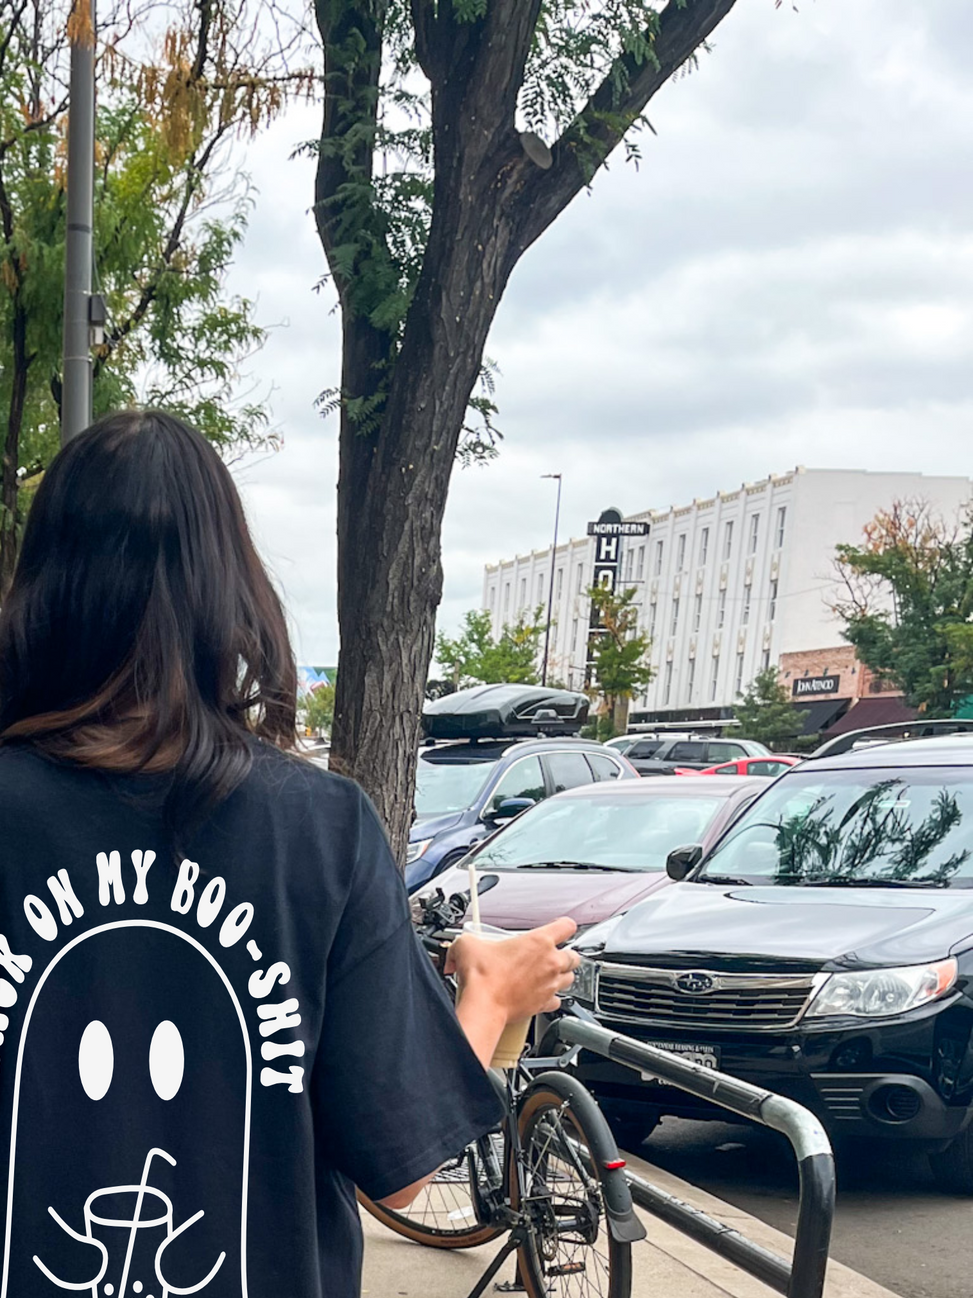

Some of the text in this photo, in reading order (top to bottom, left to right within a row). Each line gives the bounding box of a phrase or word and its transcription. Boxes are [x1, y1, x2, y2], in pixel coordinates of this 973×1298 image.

[593, 523, 645, 534] NORTHERN
[23, 868, 84, 941] ON
[96, 849, 156, 906] MY
[170, 859, 305, 1093] BOO-SHIT
